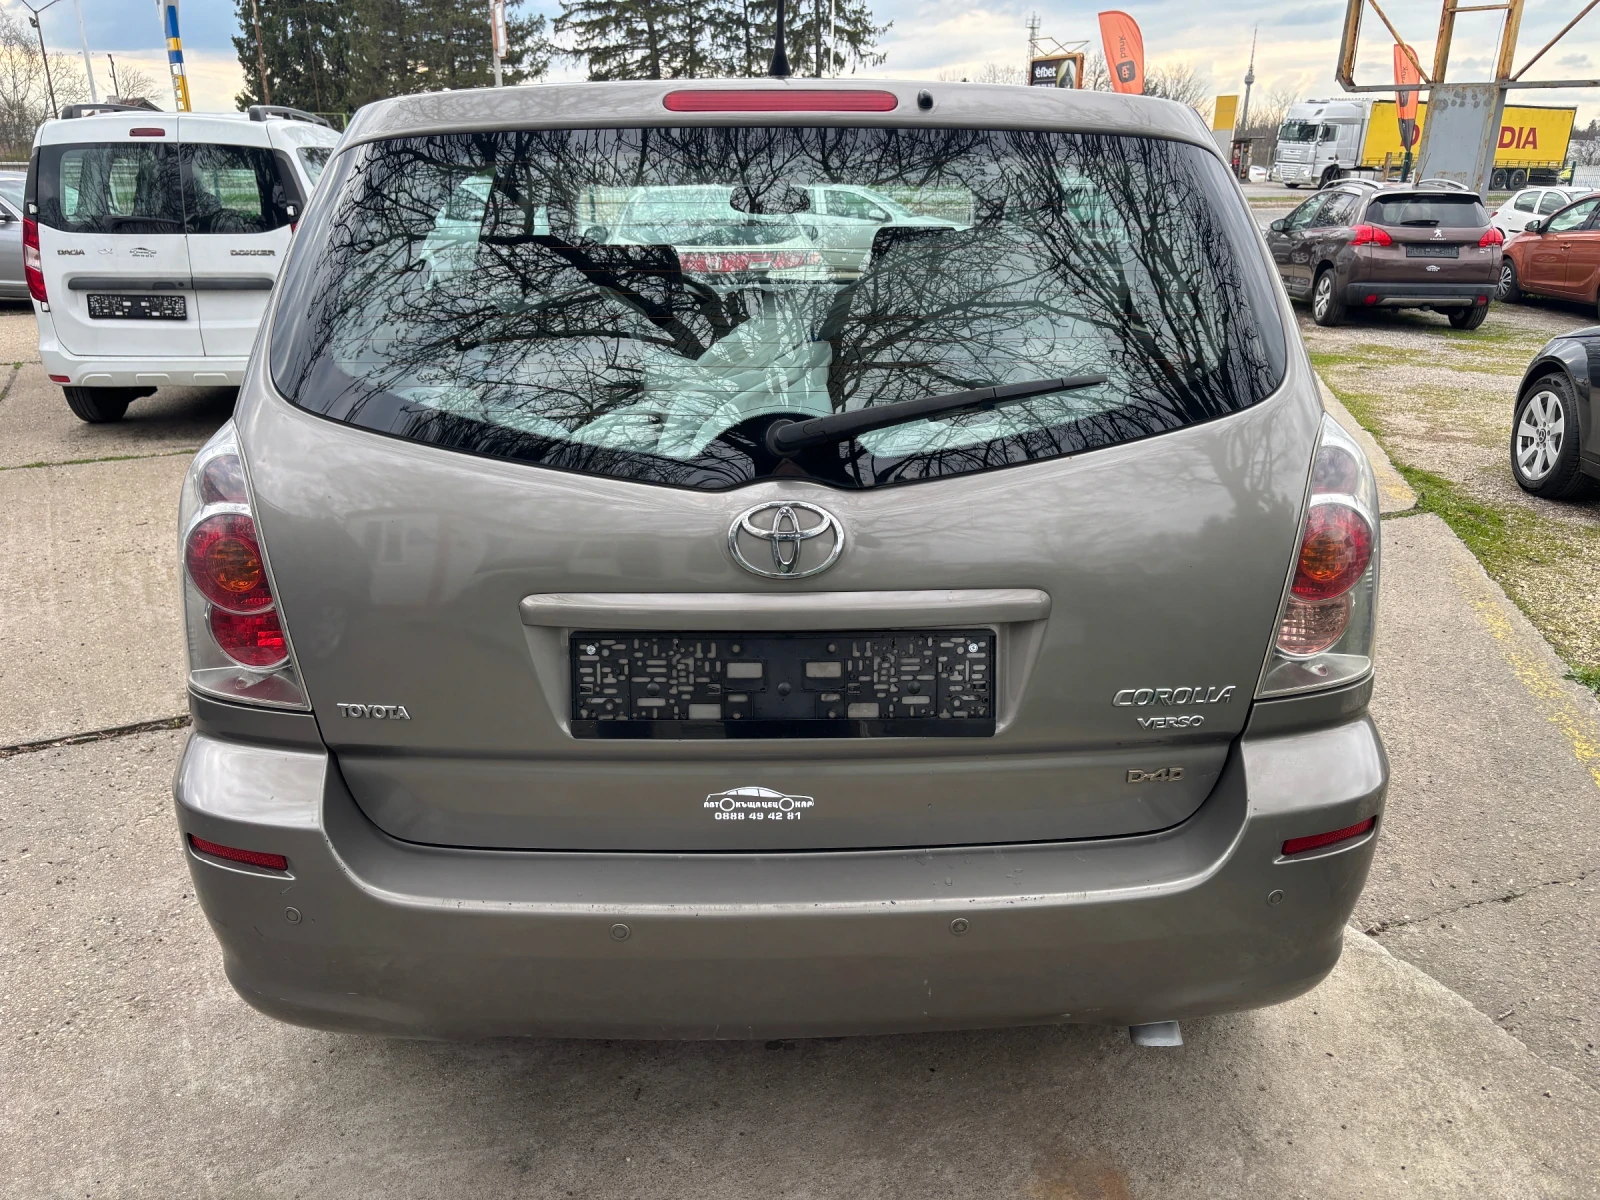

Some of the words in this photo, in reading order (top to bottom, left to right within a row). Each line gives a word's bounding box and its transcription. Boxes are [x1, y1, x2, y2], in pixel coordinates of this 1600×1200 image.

[1034, 66, 1057, 78] efbet
[1112, 686, 1237, 706] COROLLA
[336, 703, 411, 720] TOYOTA
[1136, 715, 1205, 730] VERSO
[1126, 767, 1185, 784] D-4D
[714, 812, 745, 820] 0888
[748, 812, 764, 820] 49
[768, 812, 783, 820] 42
[787, 812, 801, 820] 81
